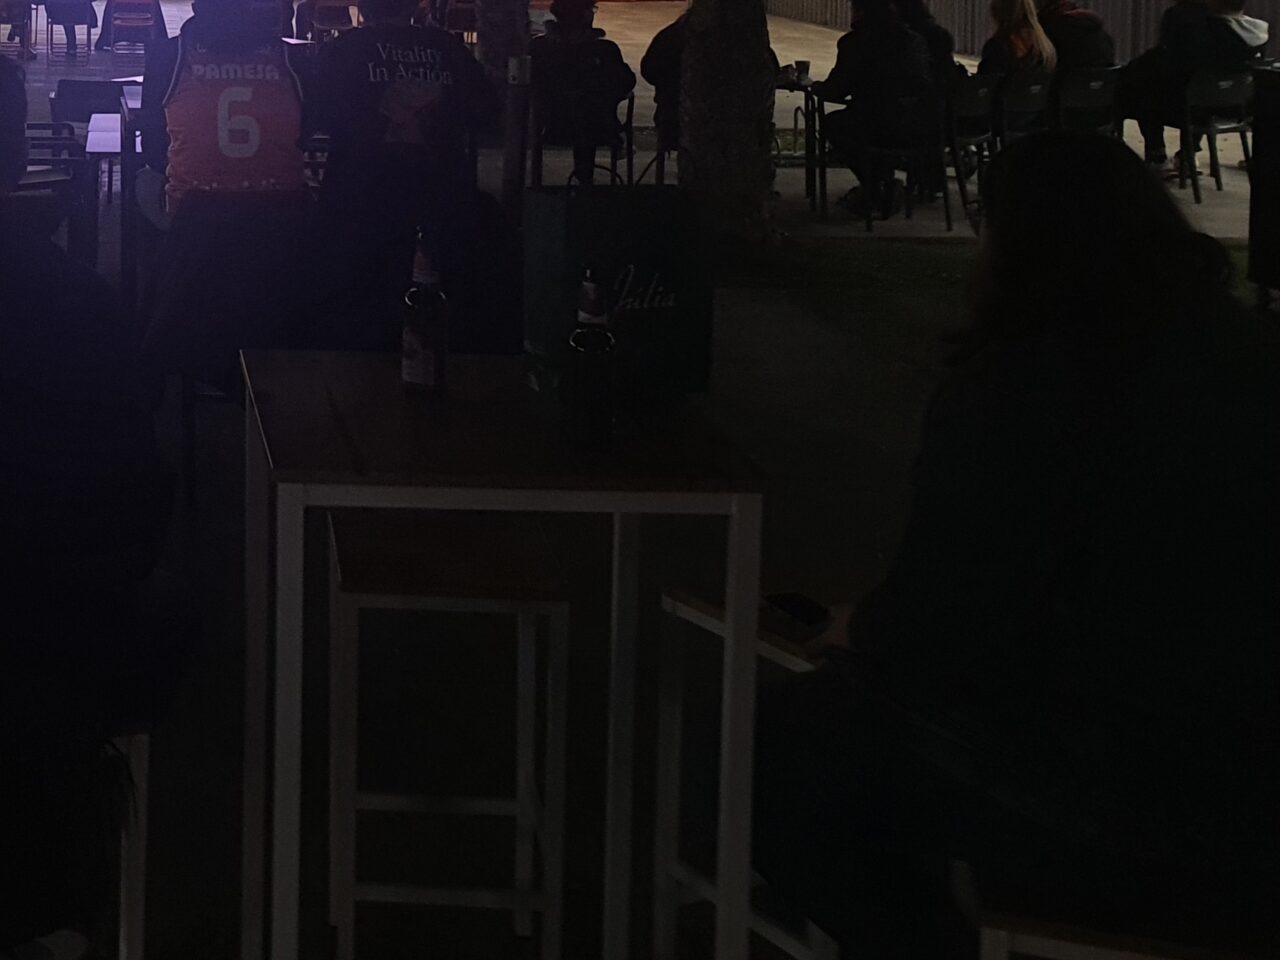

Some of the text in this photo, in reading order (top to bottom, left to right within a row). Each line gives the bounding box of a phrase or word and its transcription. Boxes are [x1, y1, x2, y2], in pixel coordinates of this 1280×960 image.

[376, 42, 442, 69] Vitality
[367, 62, 454, 84] In Action
[217, 87, 261, 158] 6
